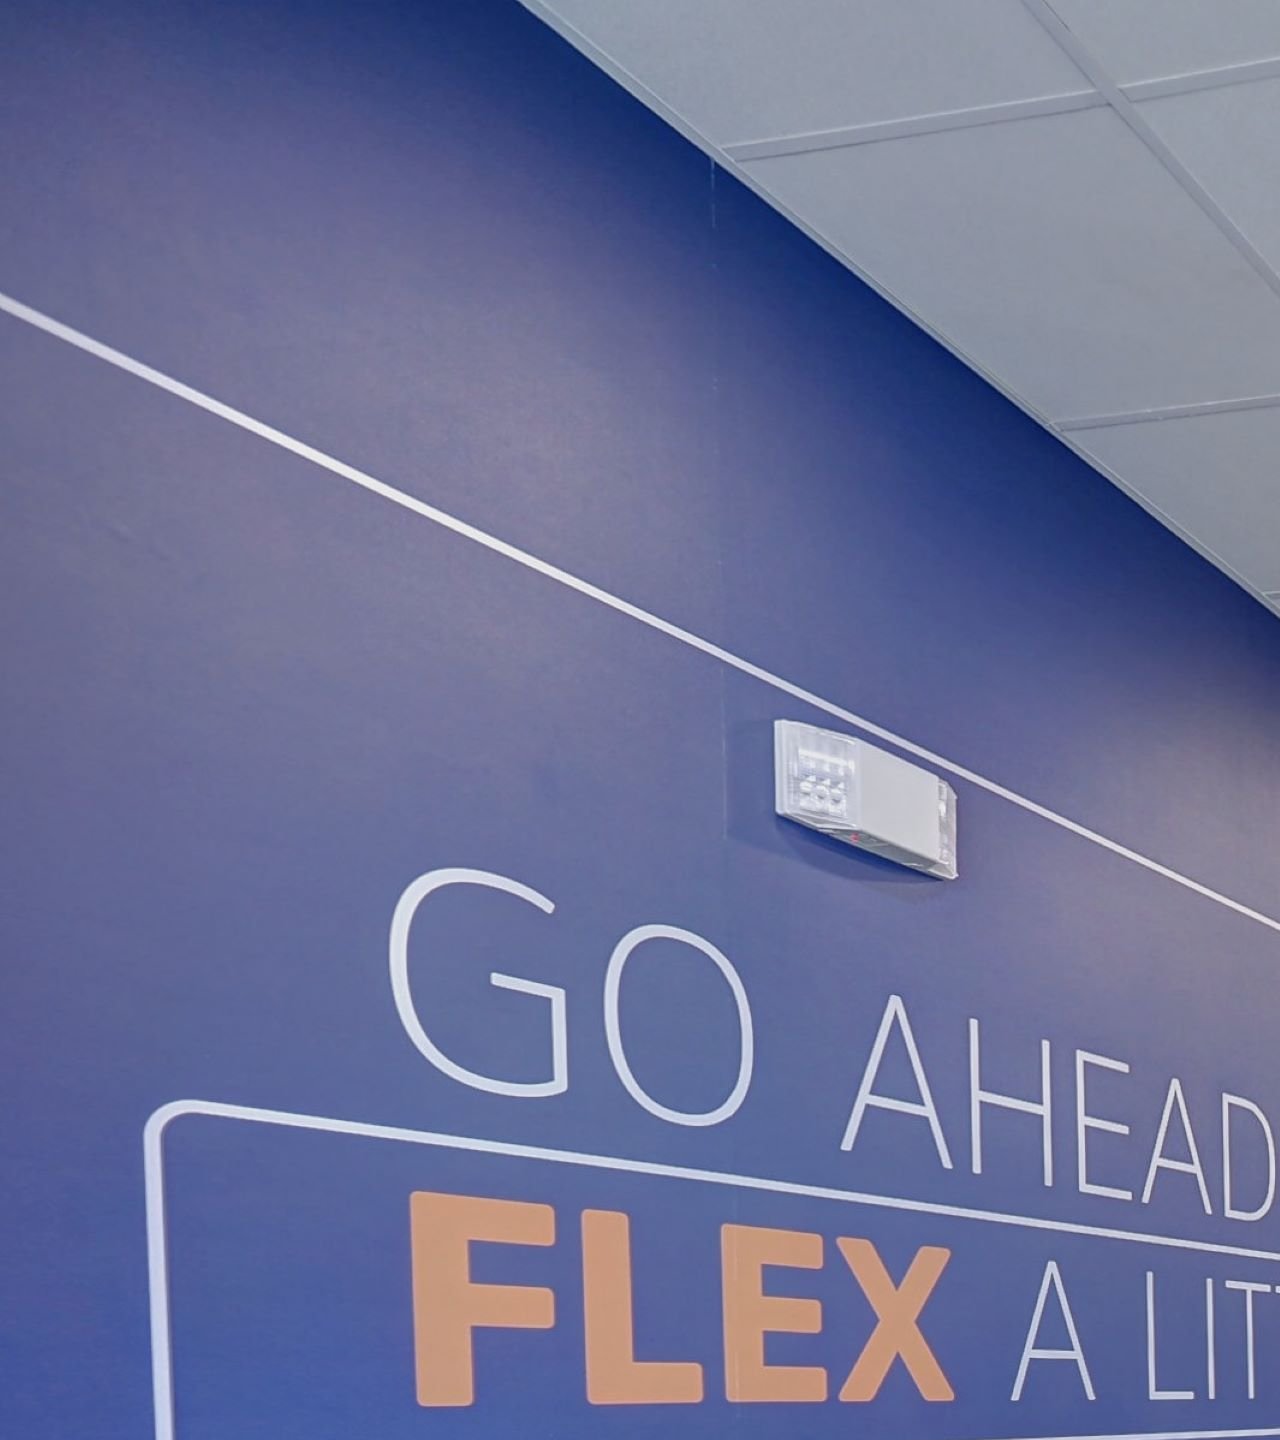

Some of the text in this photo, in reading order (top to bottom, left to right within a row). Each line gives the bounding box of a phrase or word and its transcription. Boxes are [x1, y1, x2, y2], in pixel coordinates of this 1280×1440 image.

[389, 867, 1277, 1222] GO AHEAD
[409, 1191, 955, 1407] FLEX
[1010, 1260, 1097, 1402] A
